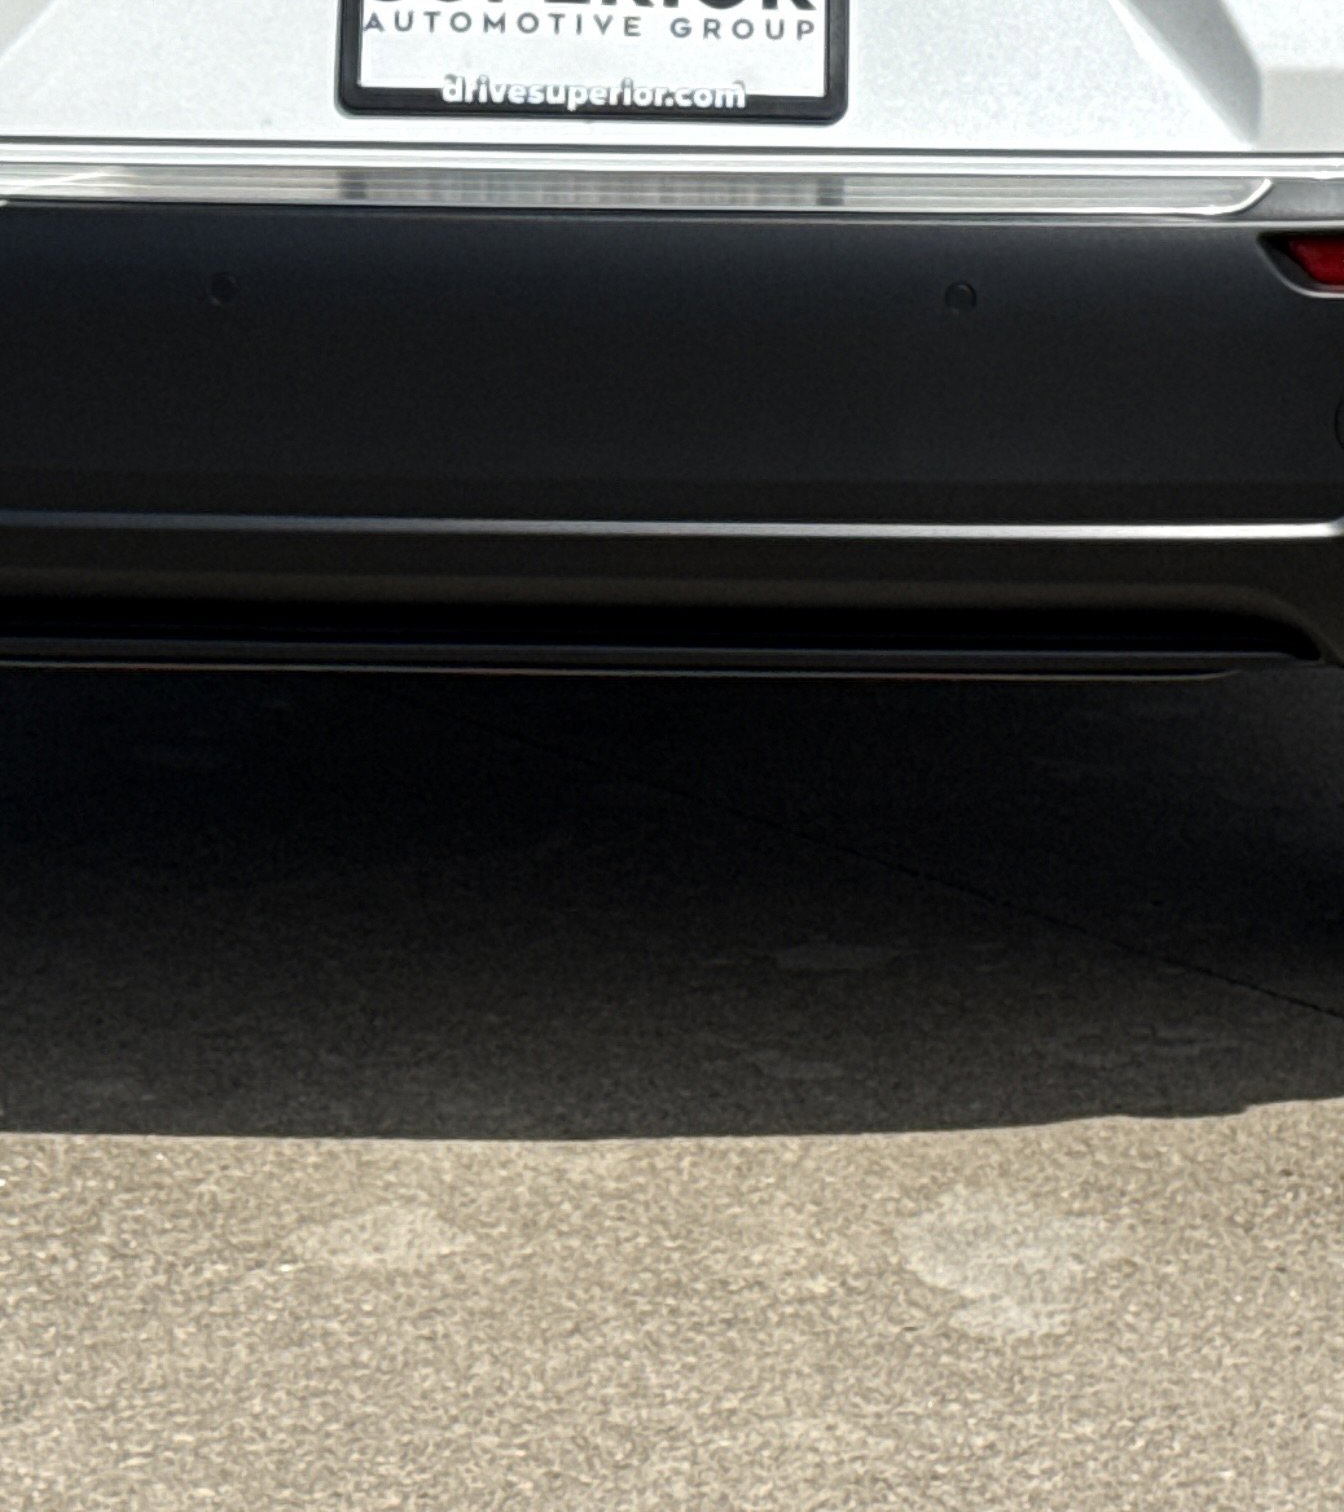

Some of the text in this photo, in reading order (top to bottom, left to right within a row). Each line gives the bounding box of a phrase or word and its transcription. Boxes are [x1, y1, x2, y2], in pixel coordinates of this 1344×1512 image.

[363, 10, 816, 42] AUTOMOTIVE GROUP
[441, 74, 747, 111] drivesuperior.com
